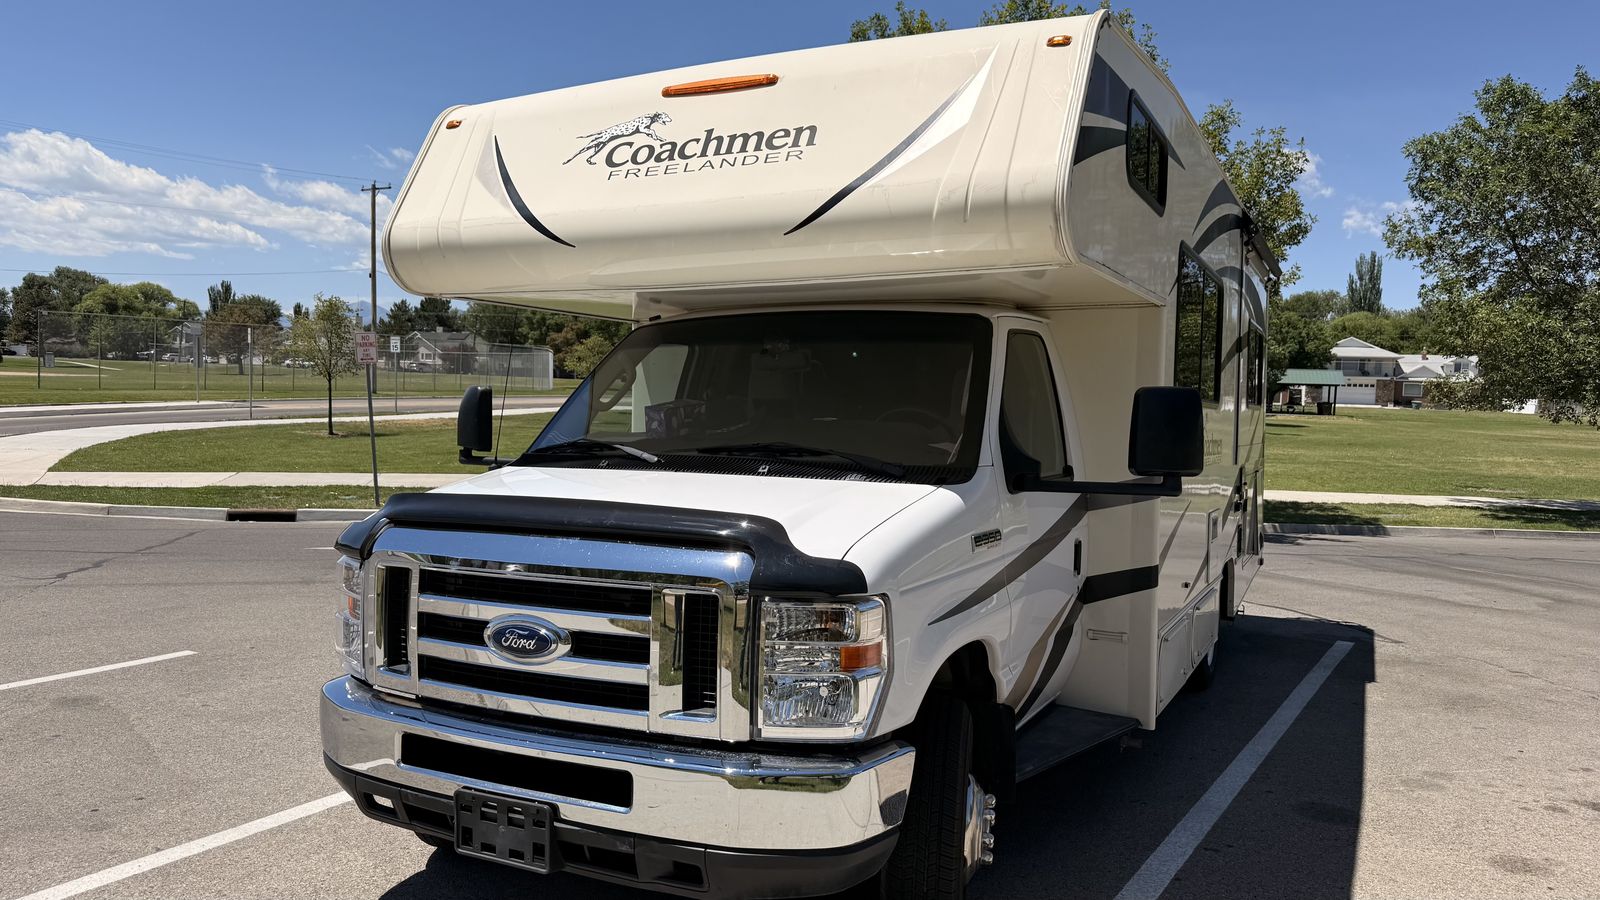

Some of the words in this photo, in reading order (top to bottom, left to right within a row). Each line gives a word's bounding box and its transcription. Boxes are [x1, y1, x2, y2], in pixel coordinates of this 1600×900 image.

[605, 124, 818, 169] Coachmen
[607, 149, 804, 181] FREELANDER
[501, 628, 538, 650] Ford
